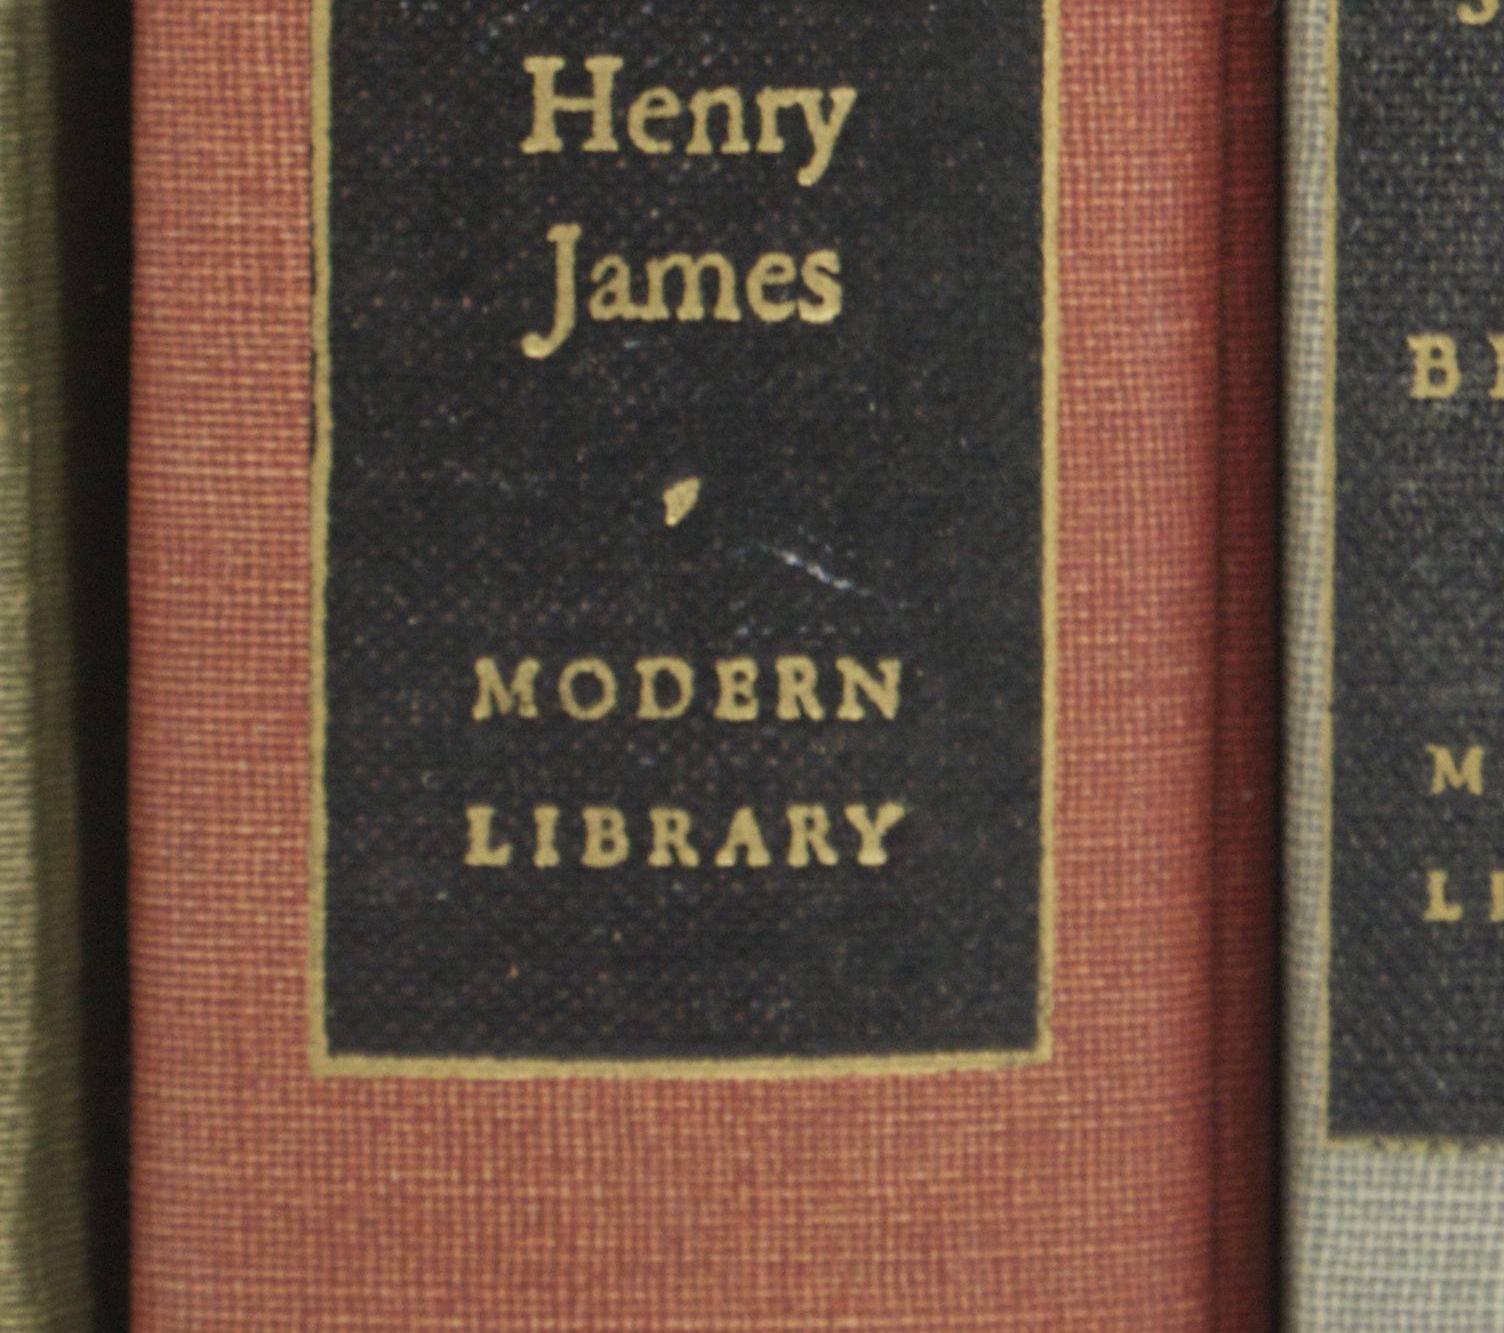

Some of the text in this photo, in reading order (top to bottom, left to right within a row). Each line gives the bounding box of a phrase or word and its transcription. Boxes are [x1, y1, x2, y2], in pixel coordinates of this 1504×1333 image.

[520, 54, 856, 186] Henry
[520, 223, 842, 358] James
[471, 655, 900, 721] MODERN
[463, 801, 906, 867] LIBRARY
